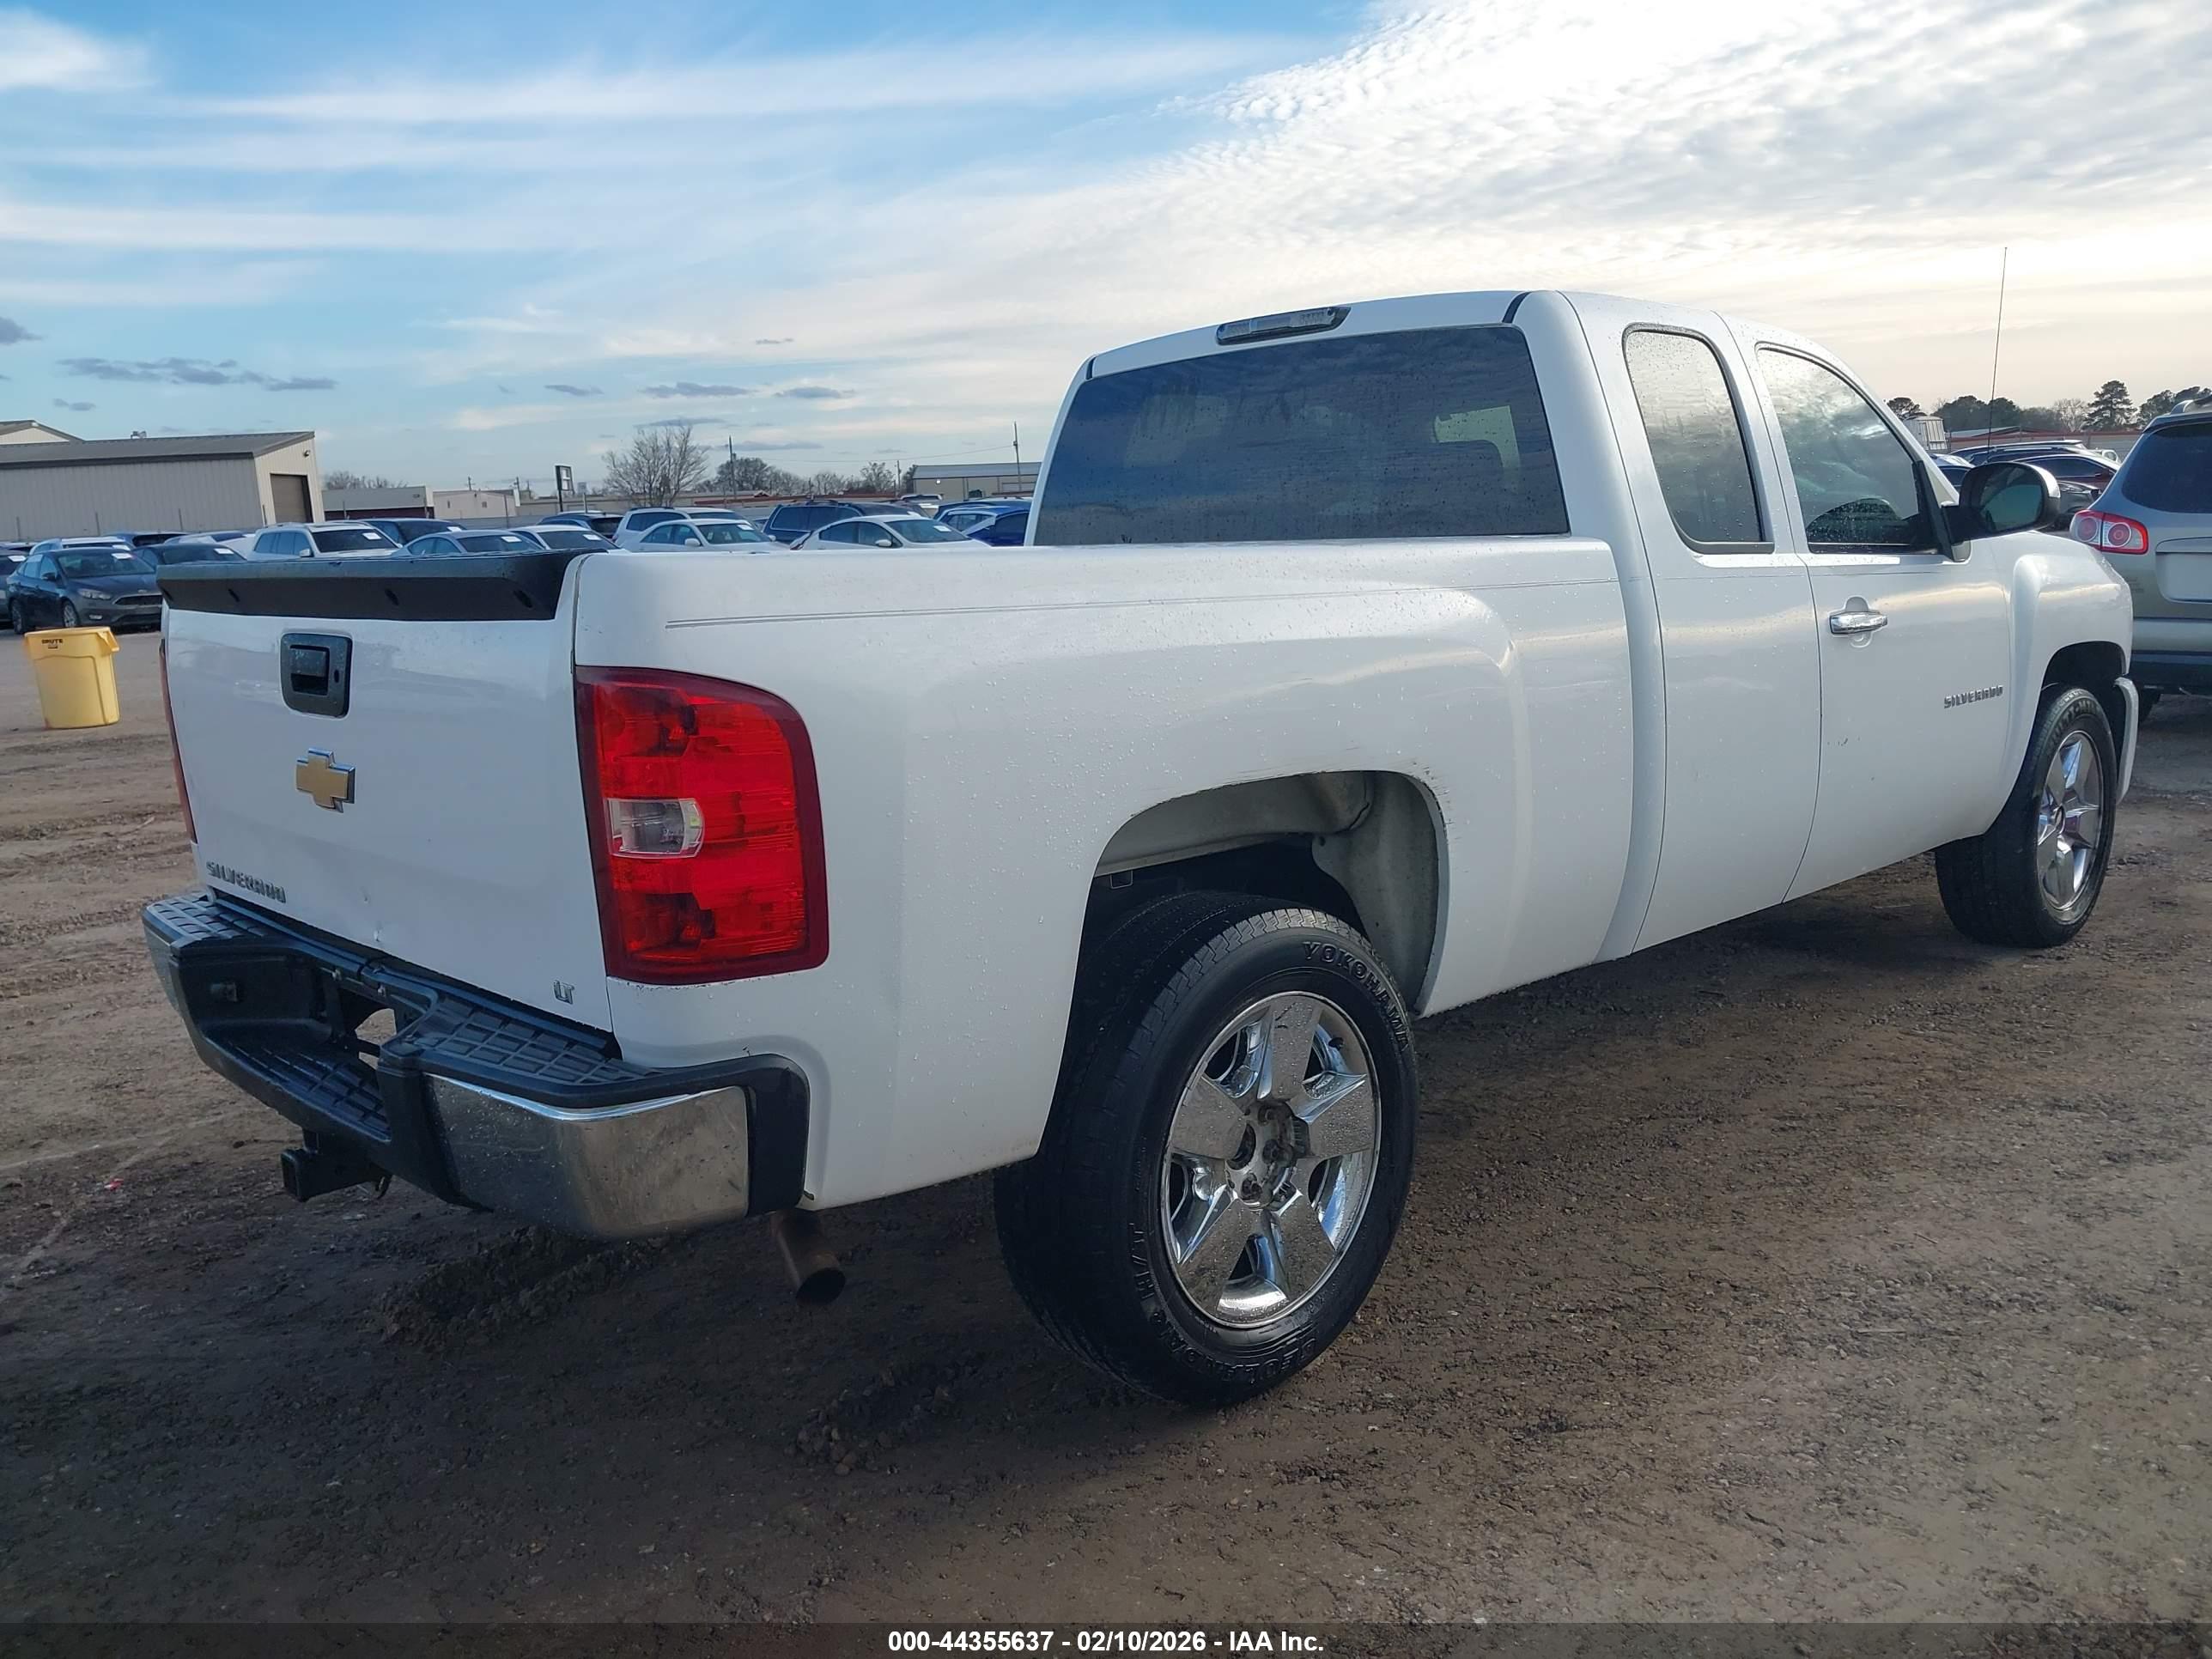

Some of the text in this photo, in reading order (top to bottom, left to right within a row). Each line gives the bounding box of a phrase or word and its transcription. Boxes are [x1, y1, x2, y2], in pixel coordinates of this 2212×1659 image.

[1943, 684, 2003, 709] SILVERADO
[206, 861, 286, 904] SILVERADO
[553, 979, 575, 1005] LT
[1303, 940, 1409, 1052] YOKOHAMA
